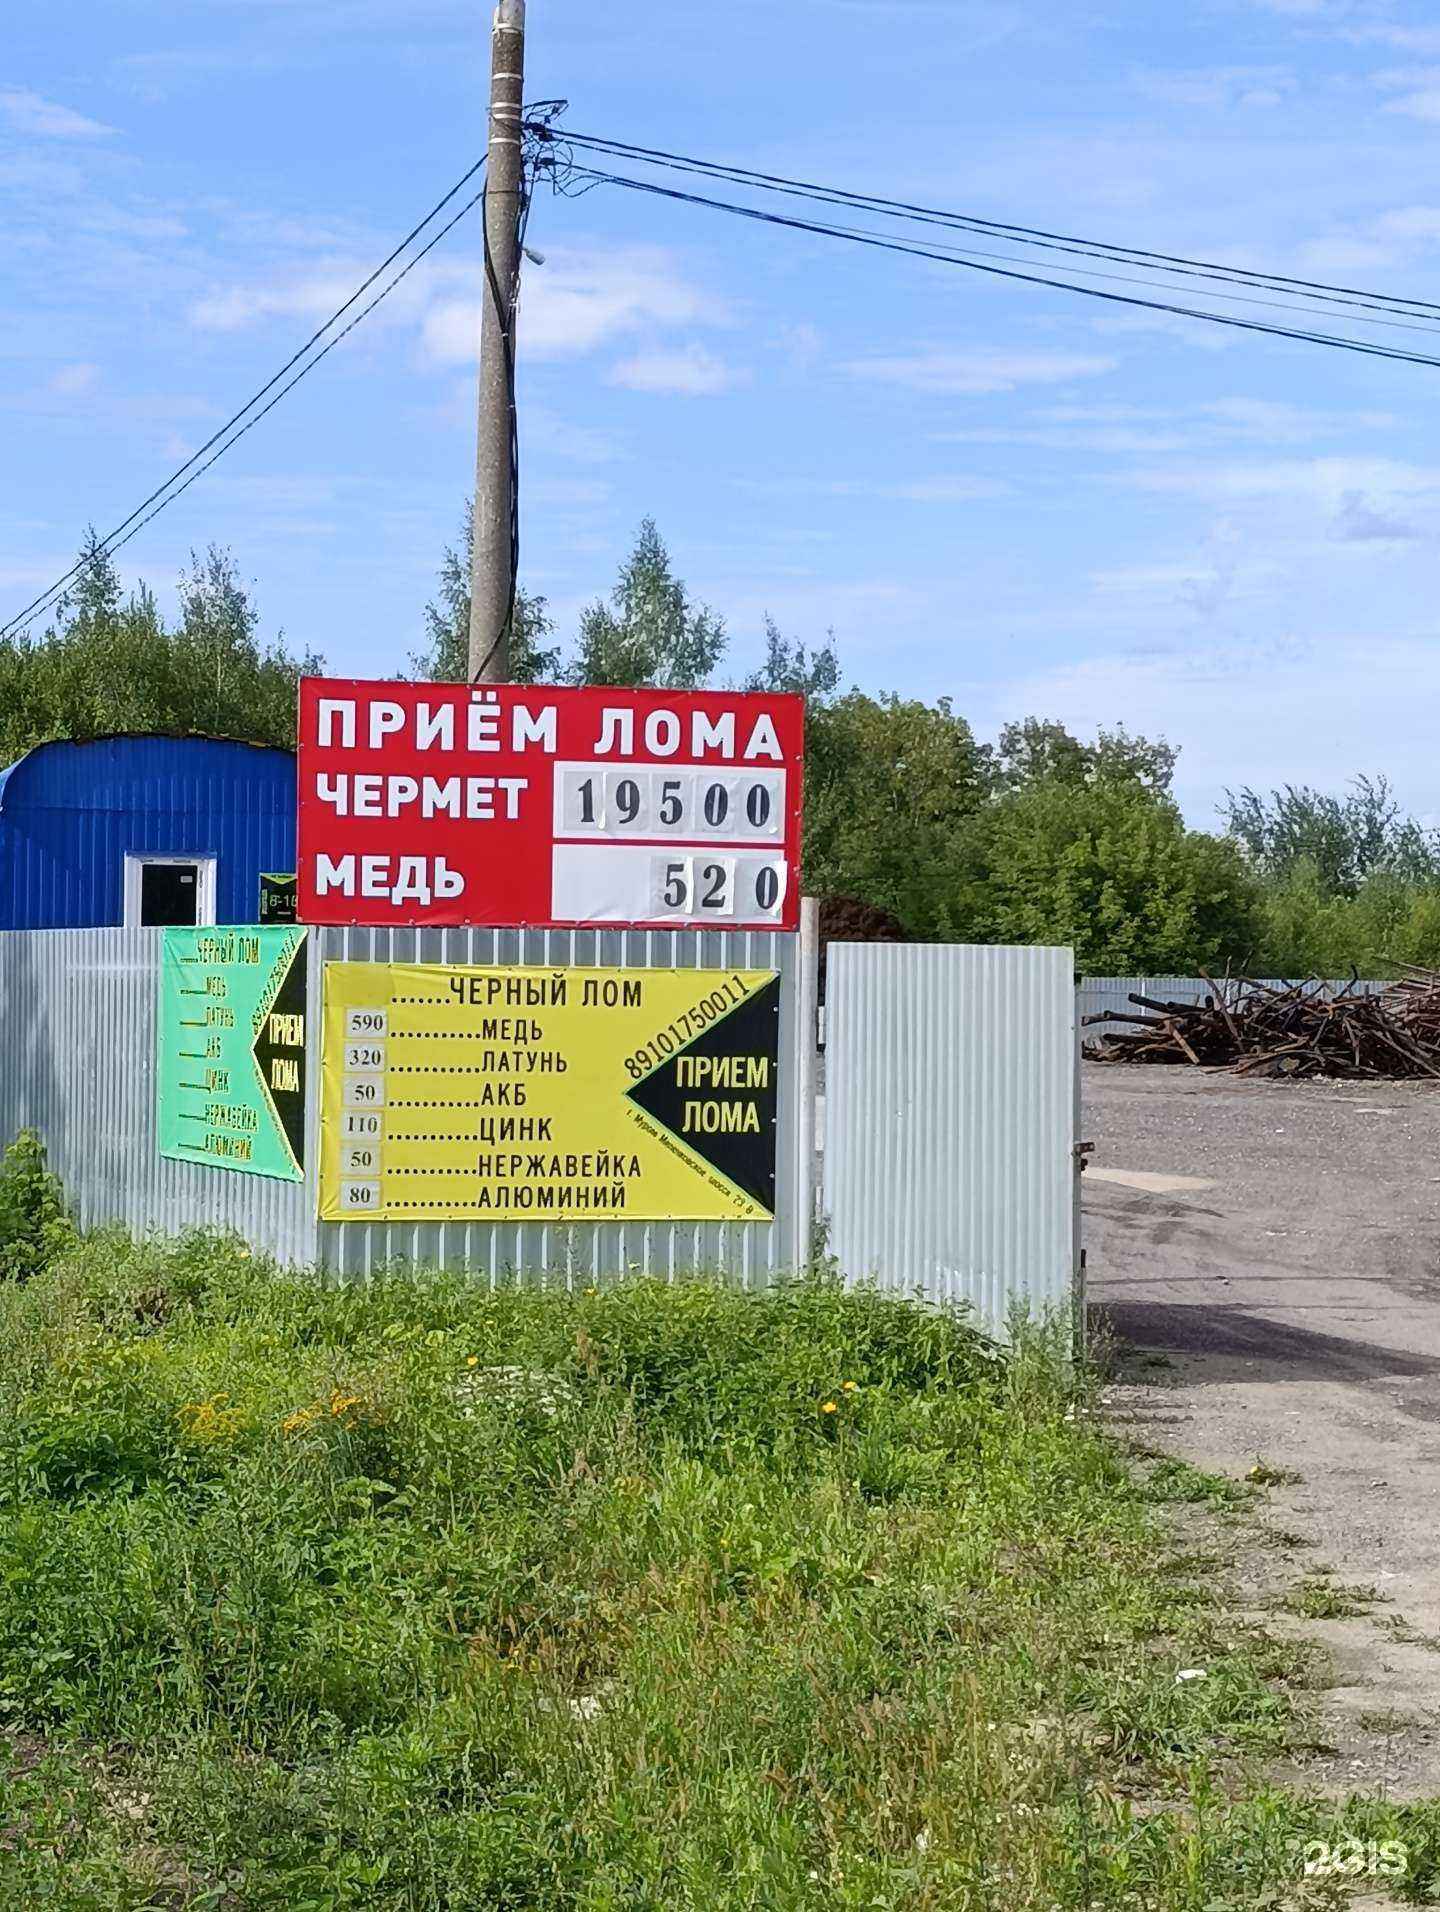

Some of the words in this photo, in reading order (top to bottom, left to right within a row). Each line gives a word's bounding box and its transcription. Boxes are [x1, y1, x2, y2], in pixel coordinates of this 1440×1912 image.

[317, 690, 558, 753] ПРИЁМ
[593, 707, 784, 761] ЛОМА
[315, 772, 529, 820] ЧЕРМЕТ
[577, 778, 771, 827] 19500
[315, 853, 465, 906] МЕДЬ
[663, 863, 779, 908] 520
[450, 973, 567, 1006] ЧЕРНЫЙ
[582, 979, 642, 1007] ЛОМ
[352, 1015, 384, 1031] 590
[482, 1019, 543, 1045] МЕДЬ
[624, 975, 750, 1079] 89101750011
[271, 1058, 299, 1092] ЛОМА
[349, 1050, 381, 1065] 320
[482, 1051, 567, 1073] ЛАТУНЬ
[676, 1056, 768, 1088] ПРИЕМ
[354, 1085, 376, 1100] 50
[482, 1083, 527, 1106] АКБ
[348, 1117, 377, 1133] 110
[480, 1118, 552, 1145] ЦИНК
[682, 1101, 760, 1133] ЛОМА
[351, 1152, 372, 1167] 50
[478, 1149, 641, 1177] НЕРЖАВЕЙКА
[350, 1187, 371, 1203] 80
[477, 1181, 626, 1208] АЛЮМИНИЙ
